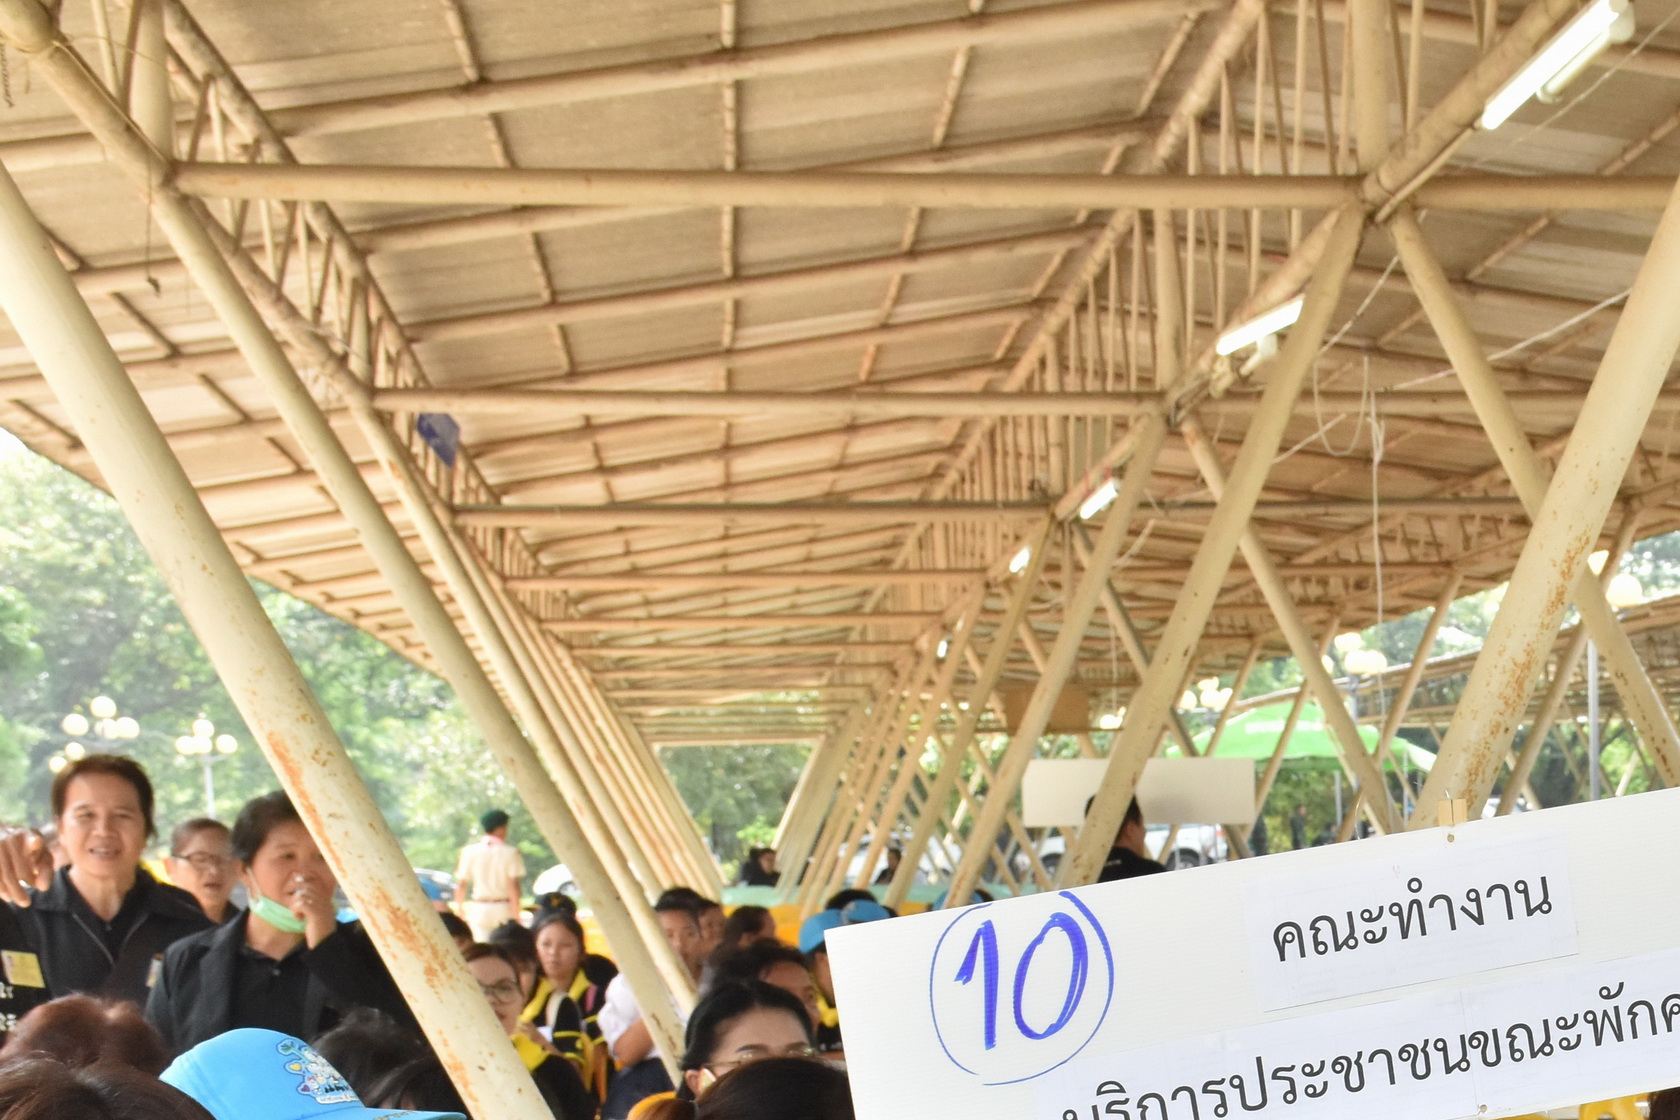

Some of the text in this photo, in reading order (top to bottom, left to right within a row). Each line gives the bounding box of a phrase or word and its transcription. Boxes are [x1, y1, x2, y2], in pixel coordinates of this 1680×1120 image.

[1273, 876, 1552, 962] คณะทำงาน
[954, 911, 1089, 1050] 10
